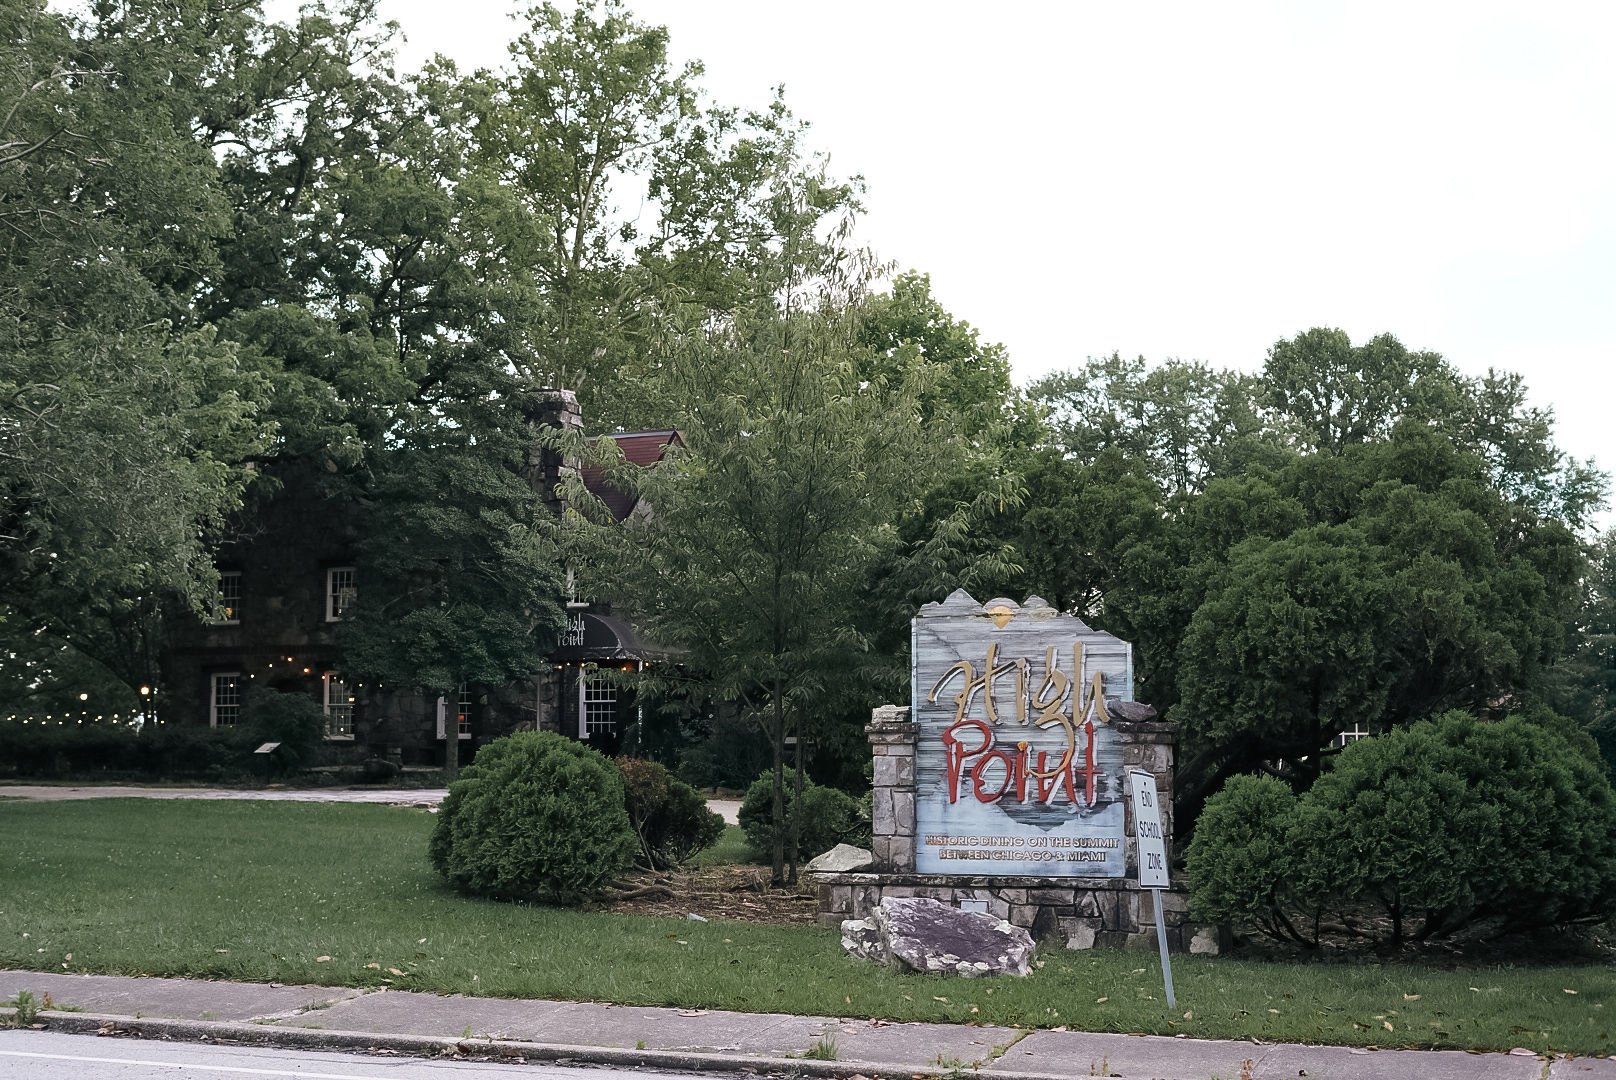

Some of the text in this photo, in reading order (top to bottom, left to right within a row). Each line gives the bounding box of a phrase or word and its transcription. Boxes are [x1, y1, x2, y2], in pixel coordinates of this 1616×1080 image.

[557, 630, 584, 647] Point
[928, 640, 1111, 778] High
[942, 719, 1107, 805] Point
[1141, 790, 1154, 808] END
[1139, 820, 1162, 840] SCHOOL
[925, 834, 1119, 849] HISTORIC DINING ON THE SUMMIT
[939, 848, 1107, 862] BETWEEN CHICAGO & MIAMI
[1147, 852, 1163, 871] ZONE
